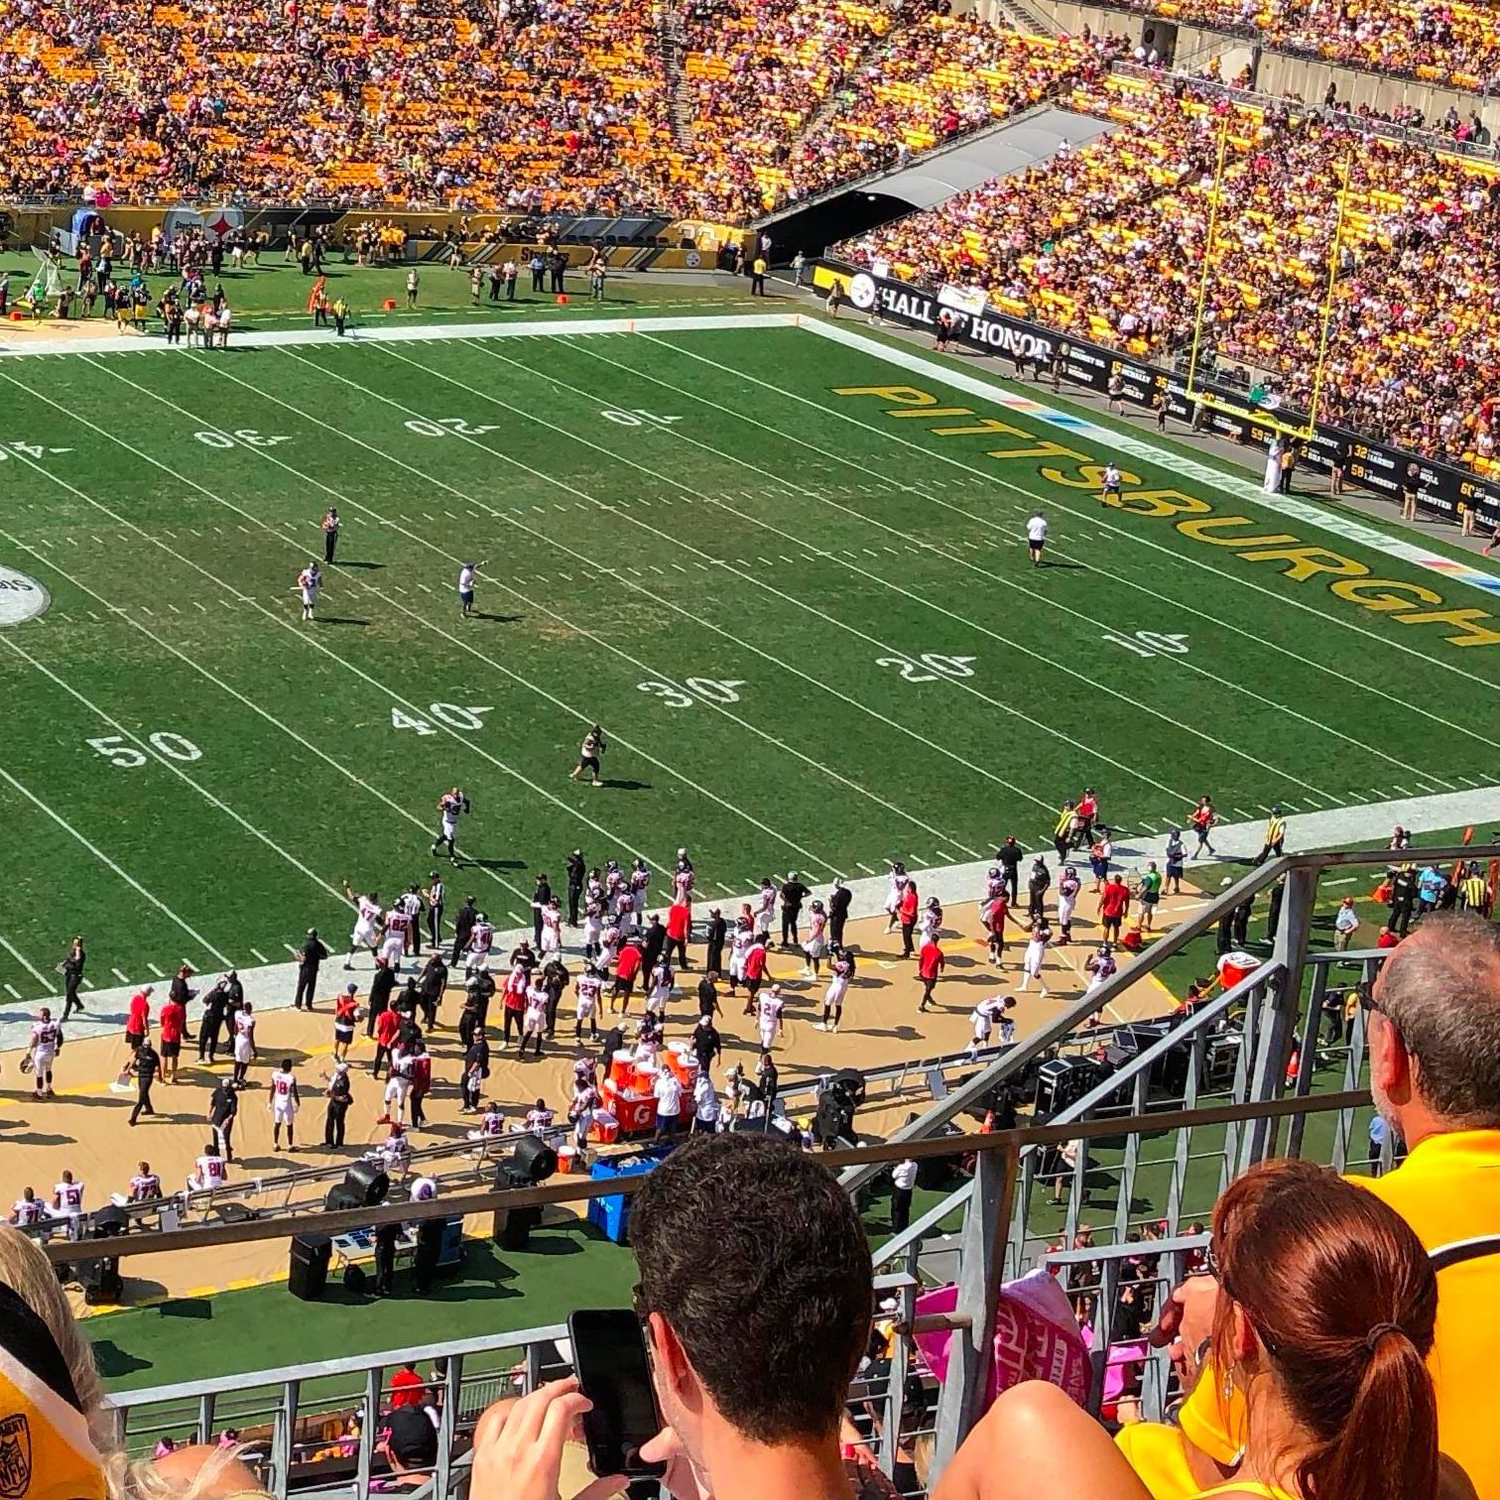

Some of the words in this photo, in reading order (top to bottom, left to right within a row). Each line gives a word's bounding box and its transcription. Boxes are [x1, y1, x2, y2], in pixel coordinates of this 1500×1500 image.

[881, 287, 935, 324] HALL
[970, 316, 1055, 363] HONOR
[1154, 375, 1169, 389] 35
[1251, 427, 1265, 441] 59
[1354, 444, 1368, 460] 32
[831, 385, 1500, 649] PITTSBURGH
[1101, 629, 1190, 658] 10
[874, 652, 975, 684] 20
[636, 676, 740, 709] 30
[389, 701, 484, 738] 40
[85, 731, 204, 768] 50
[633, 1103, 651, 1125] G
[208, 1162, 221, 1177] 81
[67, 1190, 81, 1205] 51
